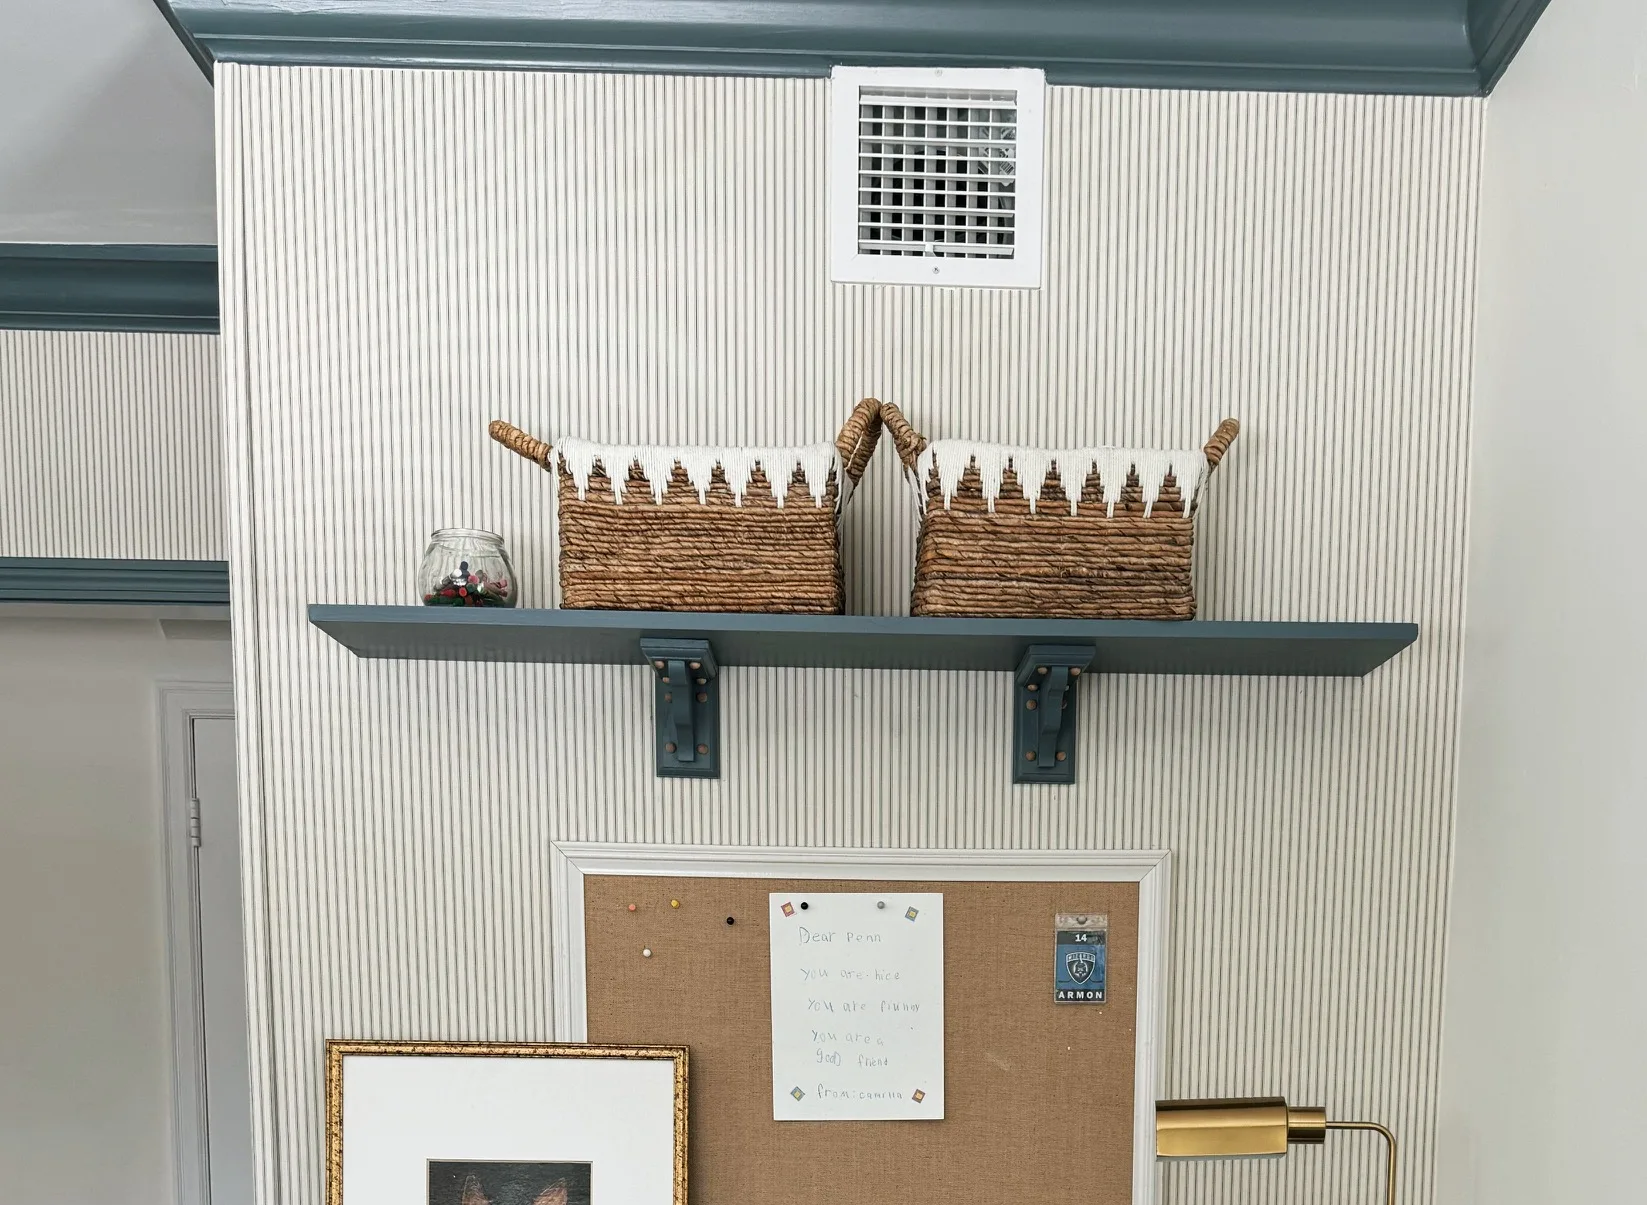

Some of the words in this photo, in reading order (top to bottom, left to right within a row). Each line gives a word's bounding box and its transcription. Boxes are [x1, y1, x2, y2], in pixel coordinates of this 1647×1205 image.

[799, 926, 836, 943] Dear
[1075, 933, 1088, 942] 14
[1058, 991, 1103, 999] ARMON
[843, 1000, 866, 1012] are
[845, 1033, 871, 1044] are
[876, 1037, 885, 1046] a
[858, 1053, 888, 1067] friend
